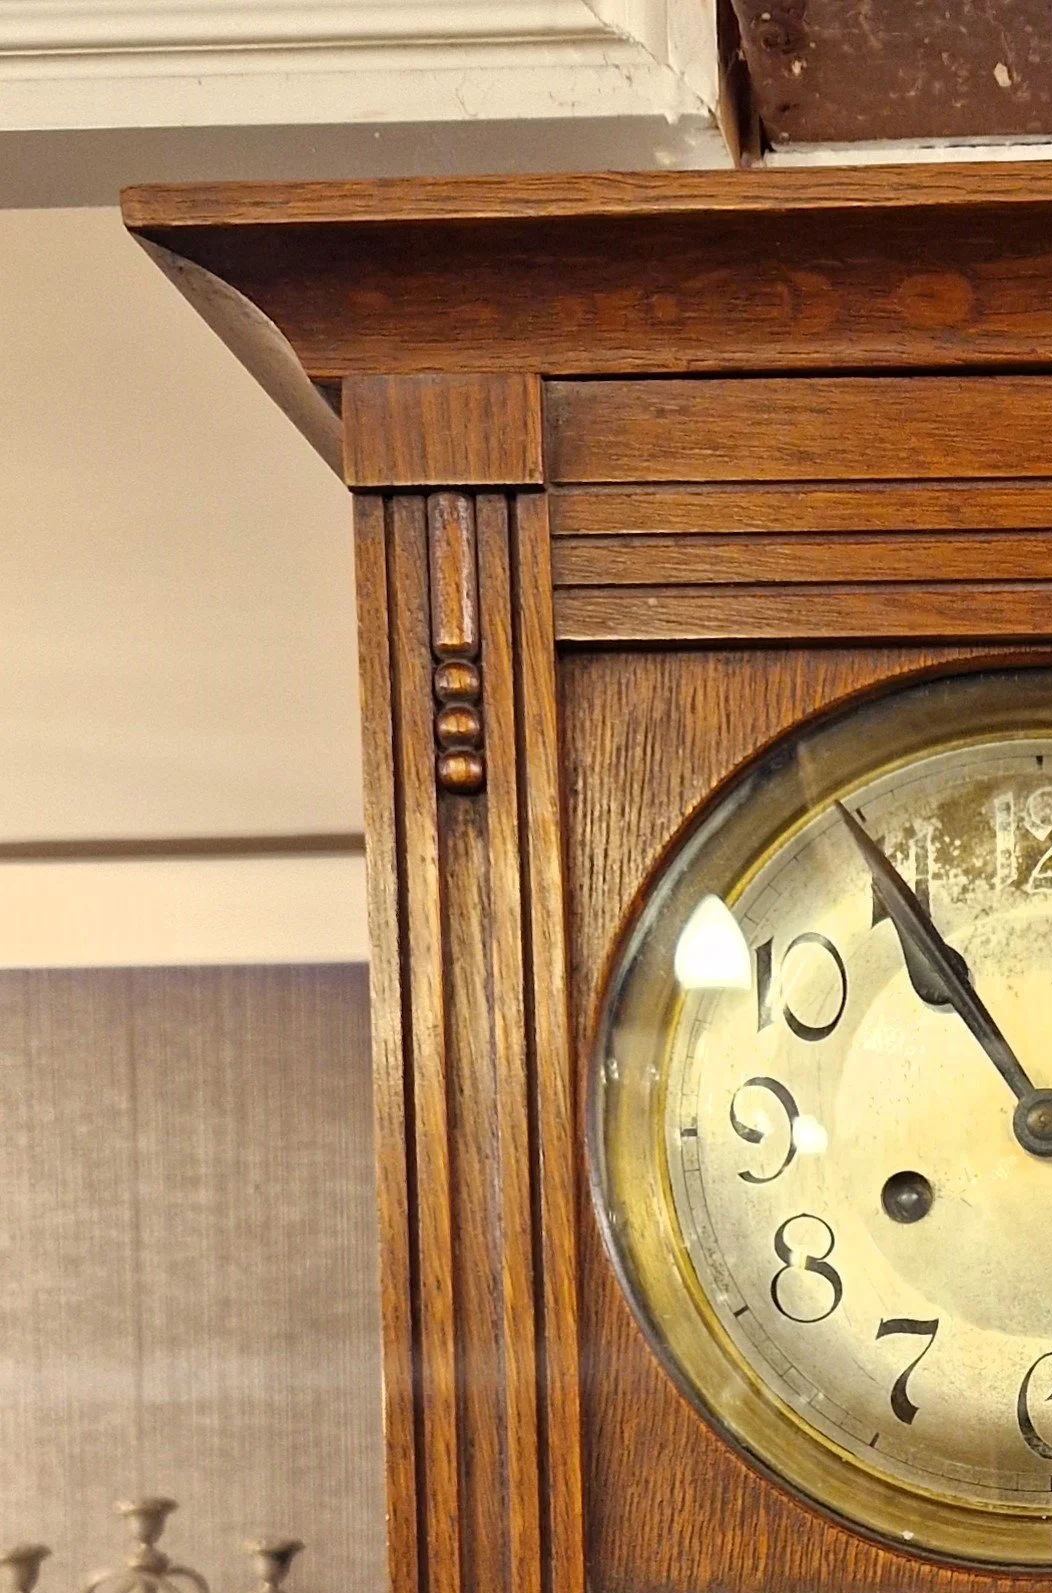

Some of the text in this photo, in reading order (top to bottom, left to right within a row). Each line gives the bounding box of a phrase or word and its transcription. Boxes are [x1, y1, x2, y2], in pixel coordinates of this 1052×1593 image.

[755, 930, 848, 1042] 10
[729, 1075, 798, 1185] 9
[770, 1212, 843, 1324] 8
[874, 1316, 940, 1425] 7
